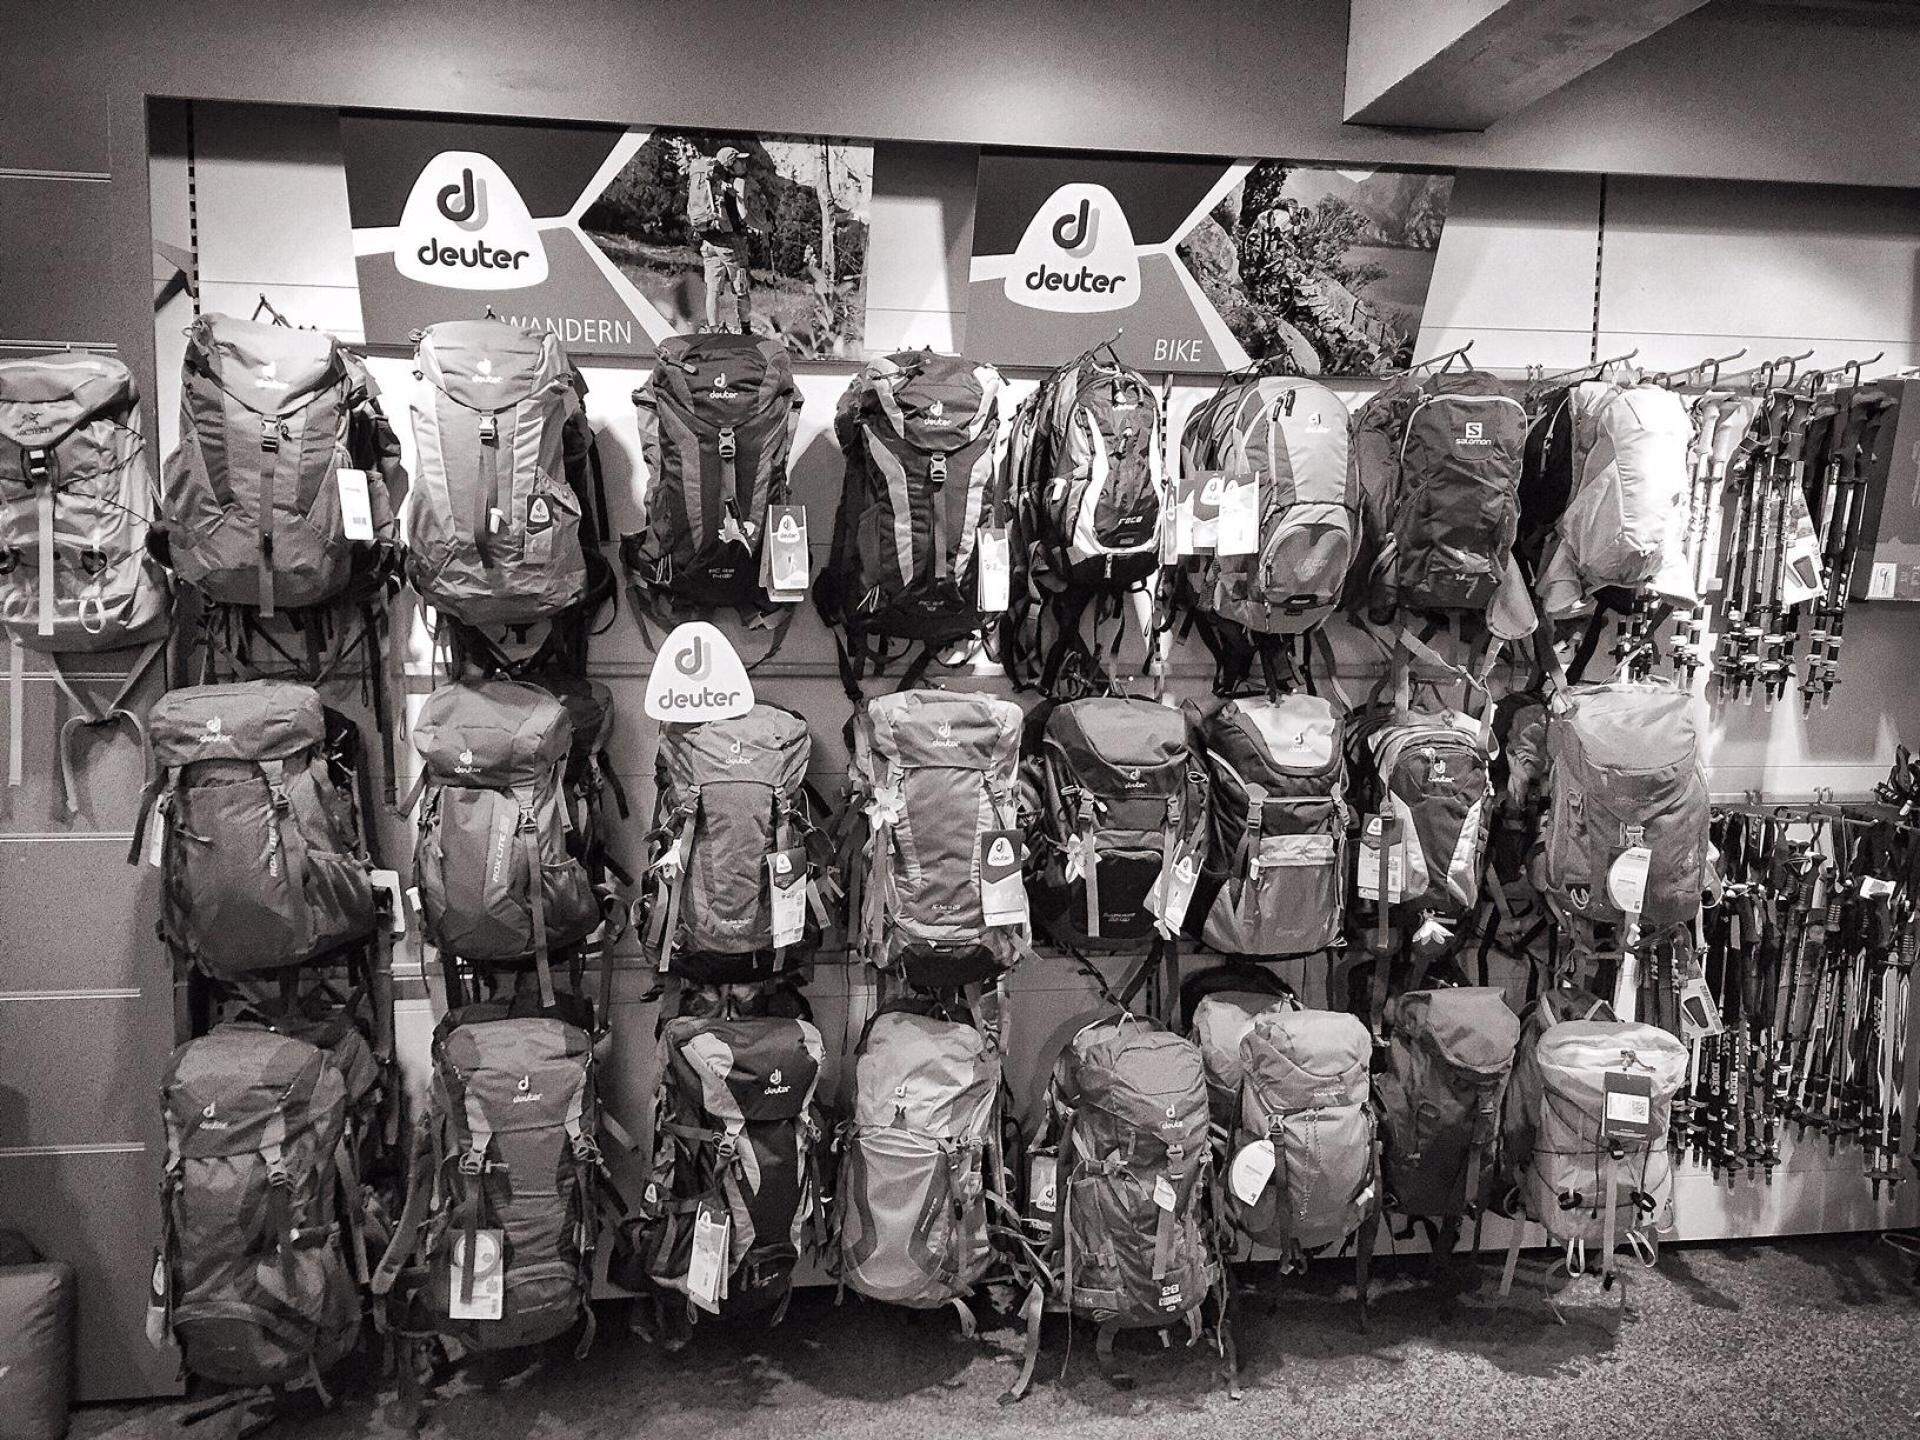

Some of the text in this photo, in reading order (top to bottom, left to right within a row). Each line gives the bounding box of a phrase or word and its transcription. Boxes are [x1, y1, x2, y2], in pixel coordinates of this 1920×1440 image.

[417, 238, 530, 270] deuter
[1024, 264, 1126, 294] deuter
[1153, 338, 1202, 362] BIKE
[709, 391, 738, 400] deuter
[1455, 438, 1492, 446] salomon
[658, 687, 741, 710] deuter
